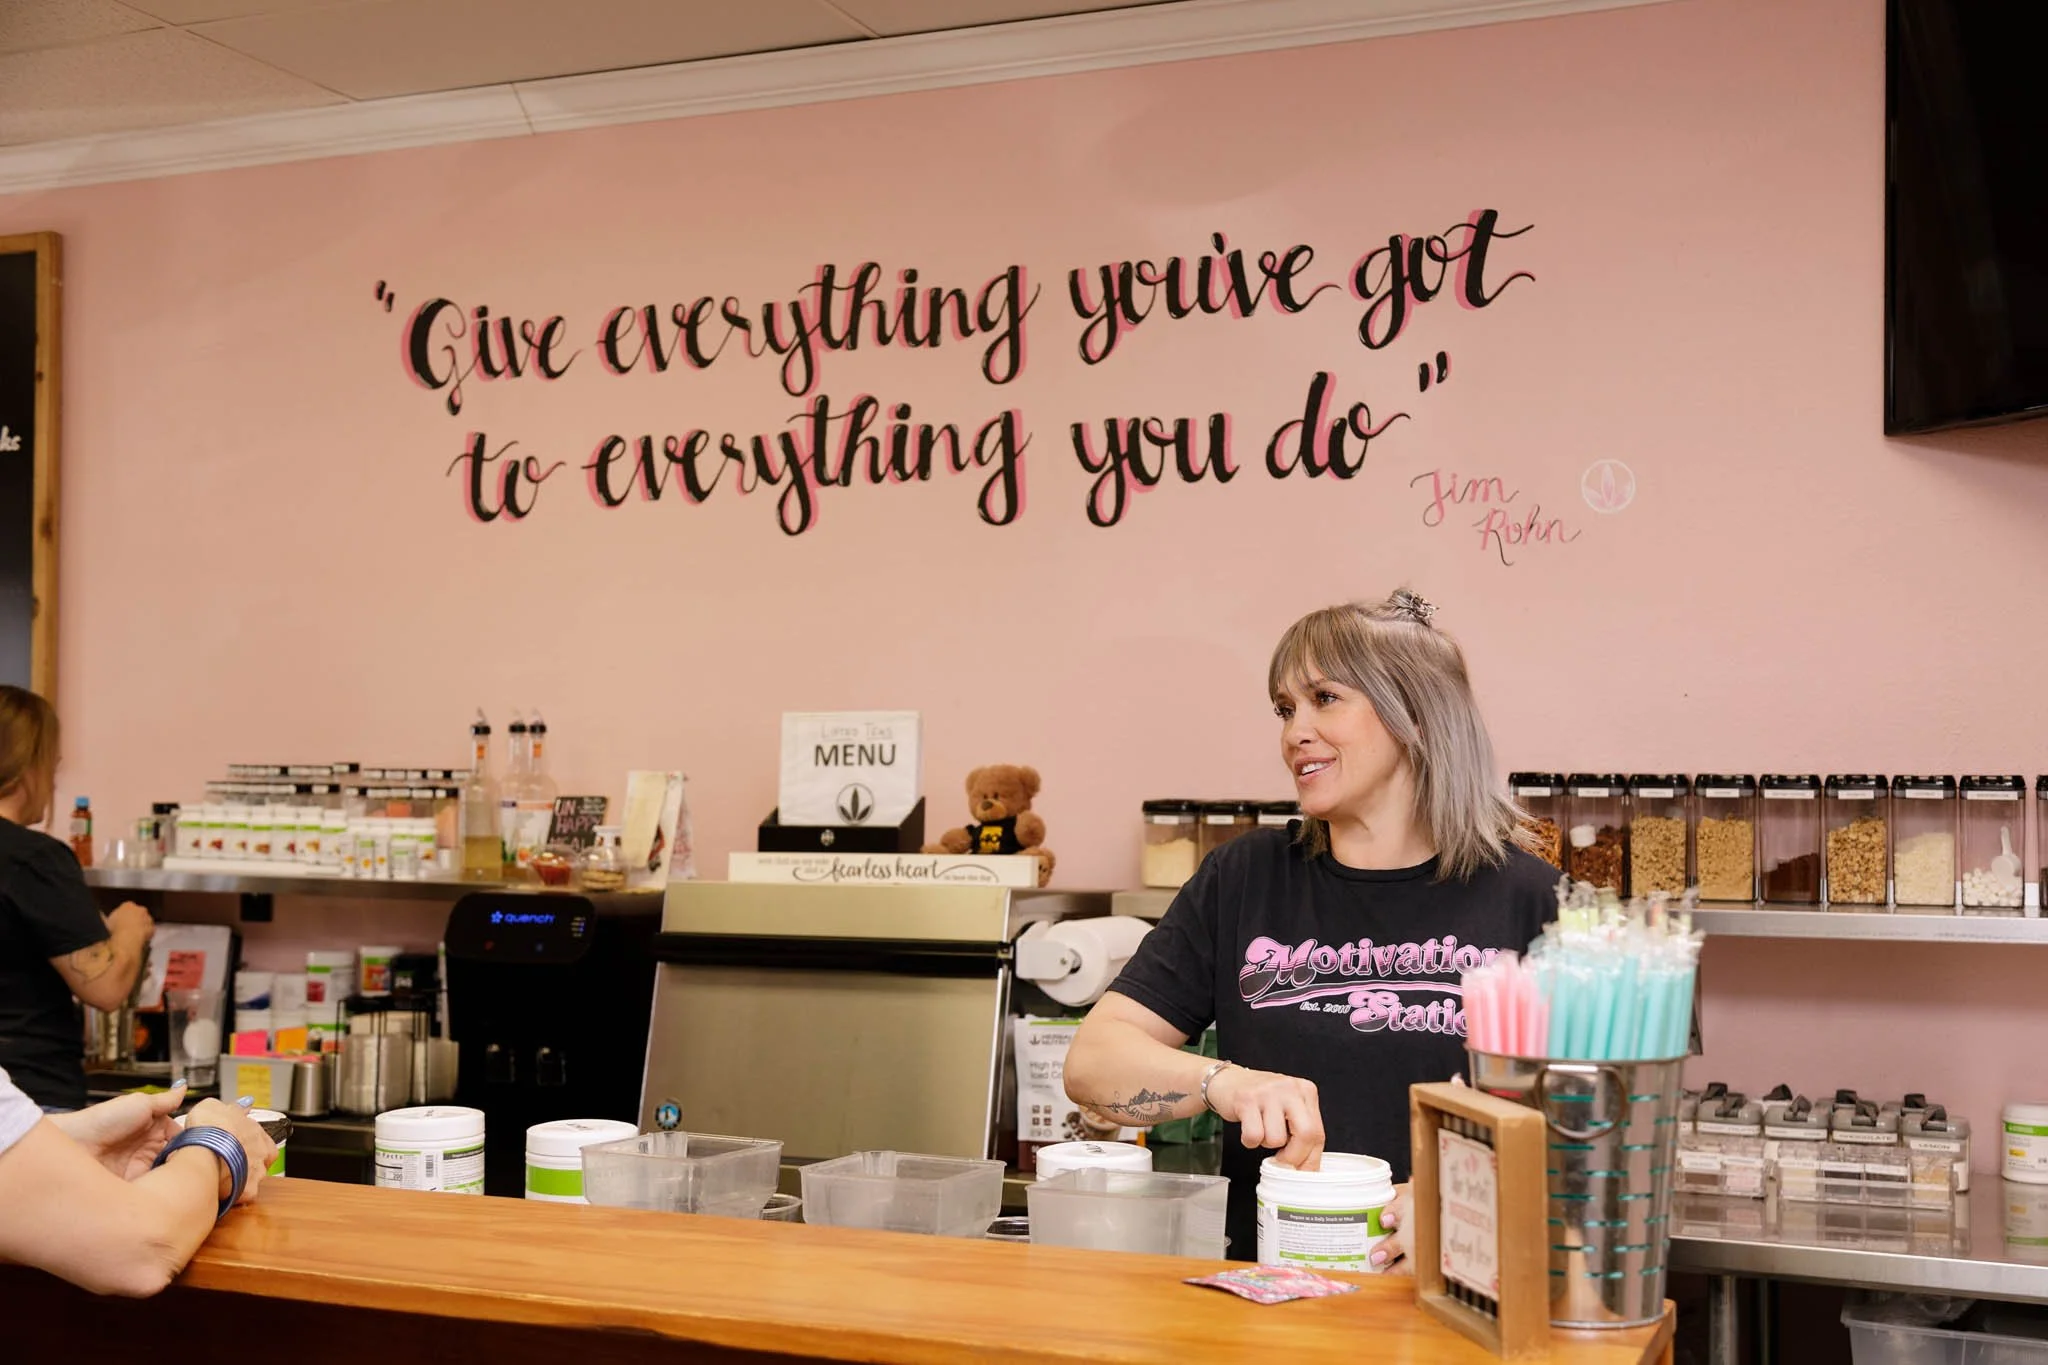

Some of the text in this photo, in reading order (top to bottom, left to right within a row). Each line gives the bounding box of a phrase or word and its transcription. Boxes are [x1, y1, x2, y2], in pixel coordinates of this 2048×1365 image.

[596, 261, 1042, 397] everything
[1350, 208, 1536, 350] got
[446, 431, 567, 522] to
[581, 393, 1034, 536] everything
[1070, 410, 1241, 527] you
[1409, 468, 1520, 528] Jim
[1471, 503, 1582, 567] Rohn
[814, 743, 897, 767] MENU
[828, 857, 940, 883] fearless heart
